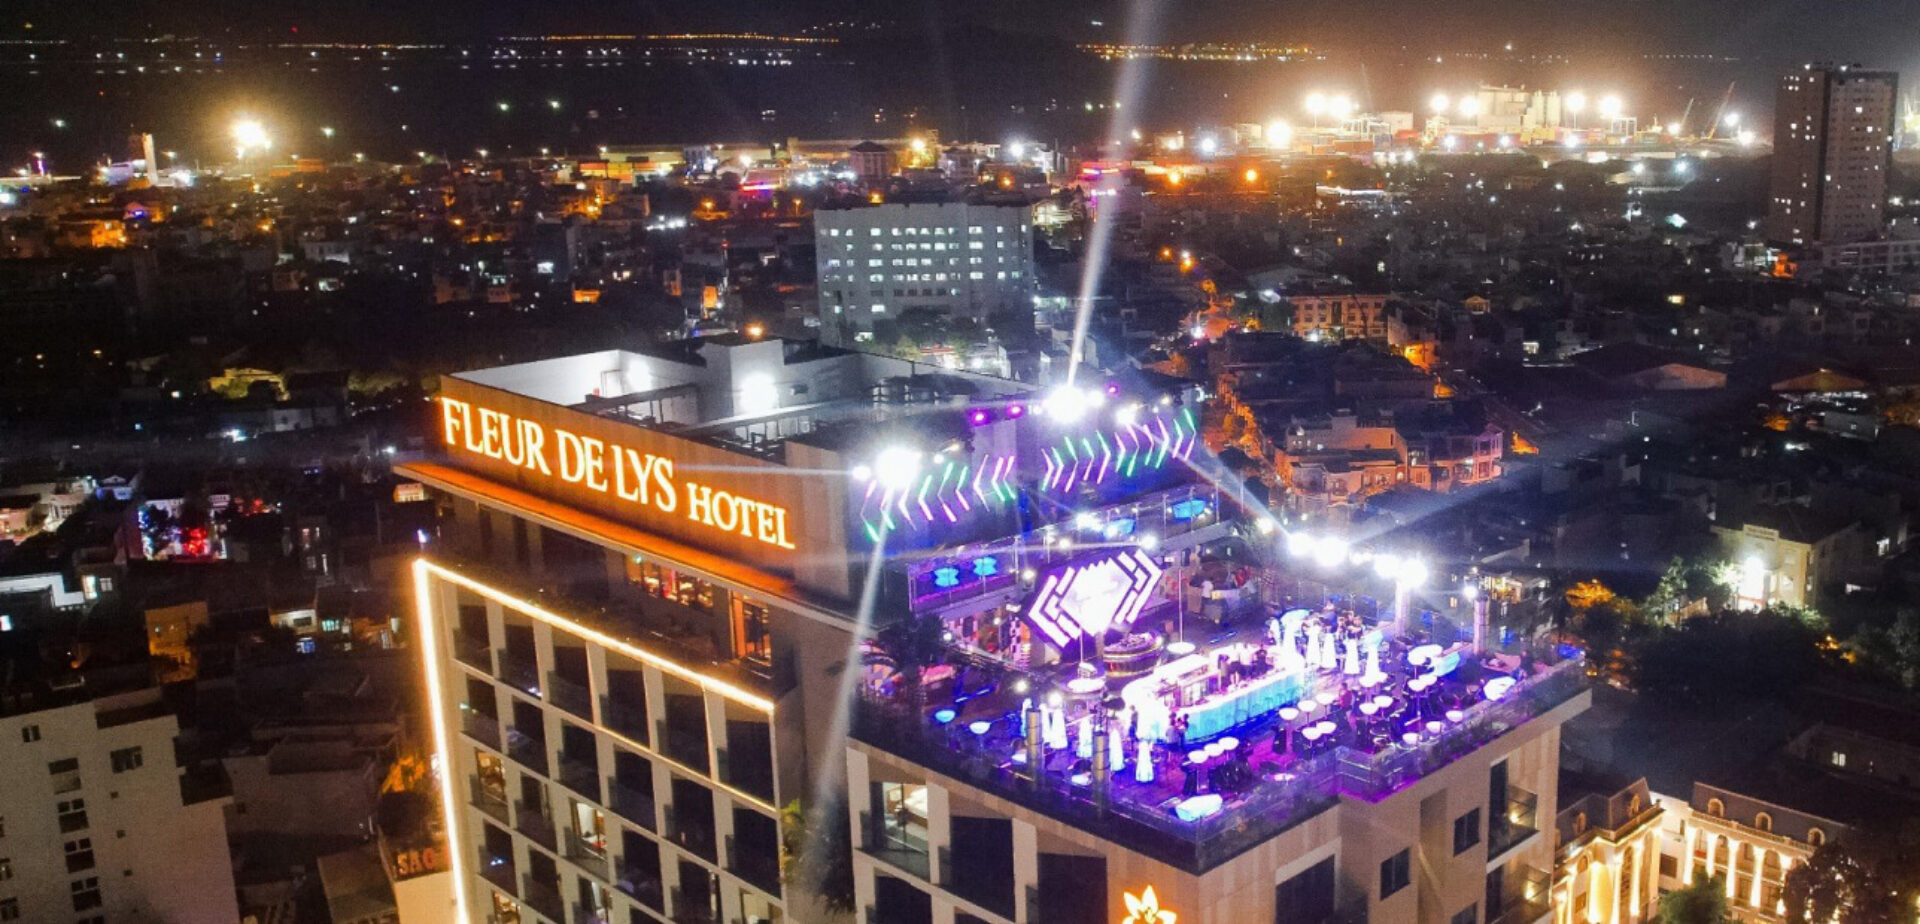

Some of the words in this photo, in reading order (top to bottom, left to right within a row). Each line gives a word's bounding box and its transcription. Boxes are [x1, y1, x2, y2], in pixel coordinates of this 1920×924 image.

[441, 397, 552, 476] FLEUR
[554, 429, 608, 492] DE
[611, 445, 677, 513] LYS
[686, 482, 796, 550] HOTEL
